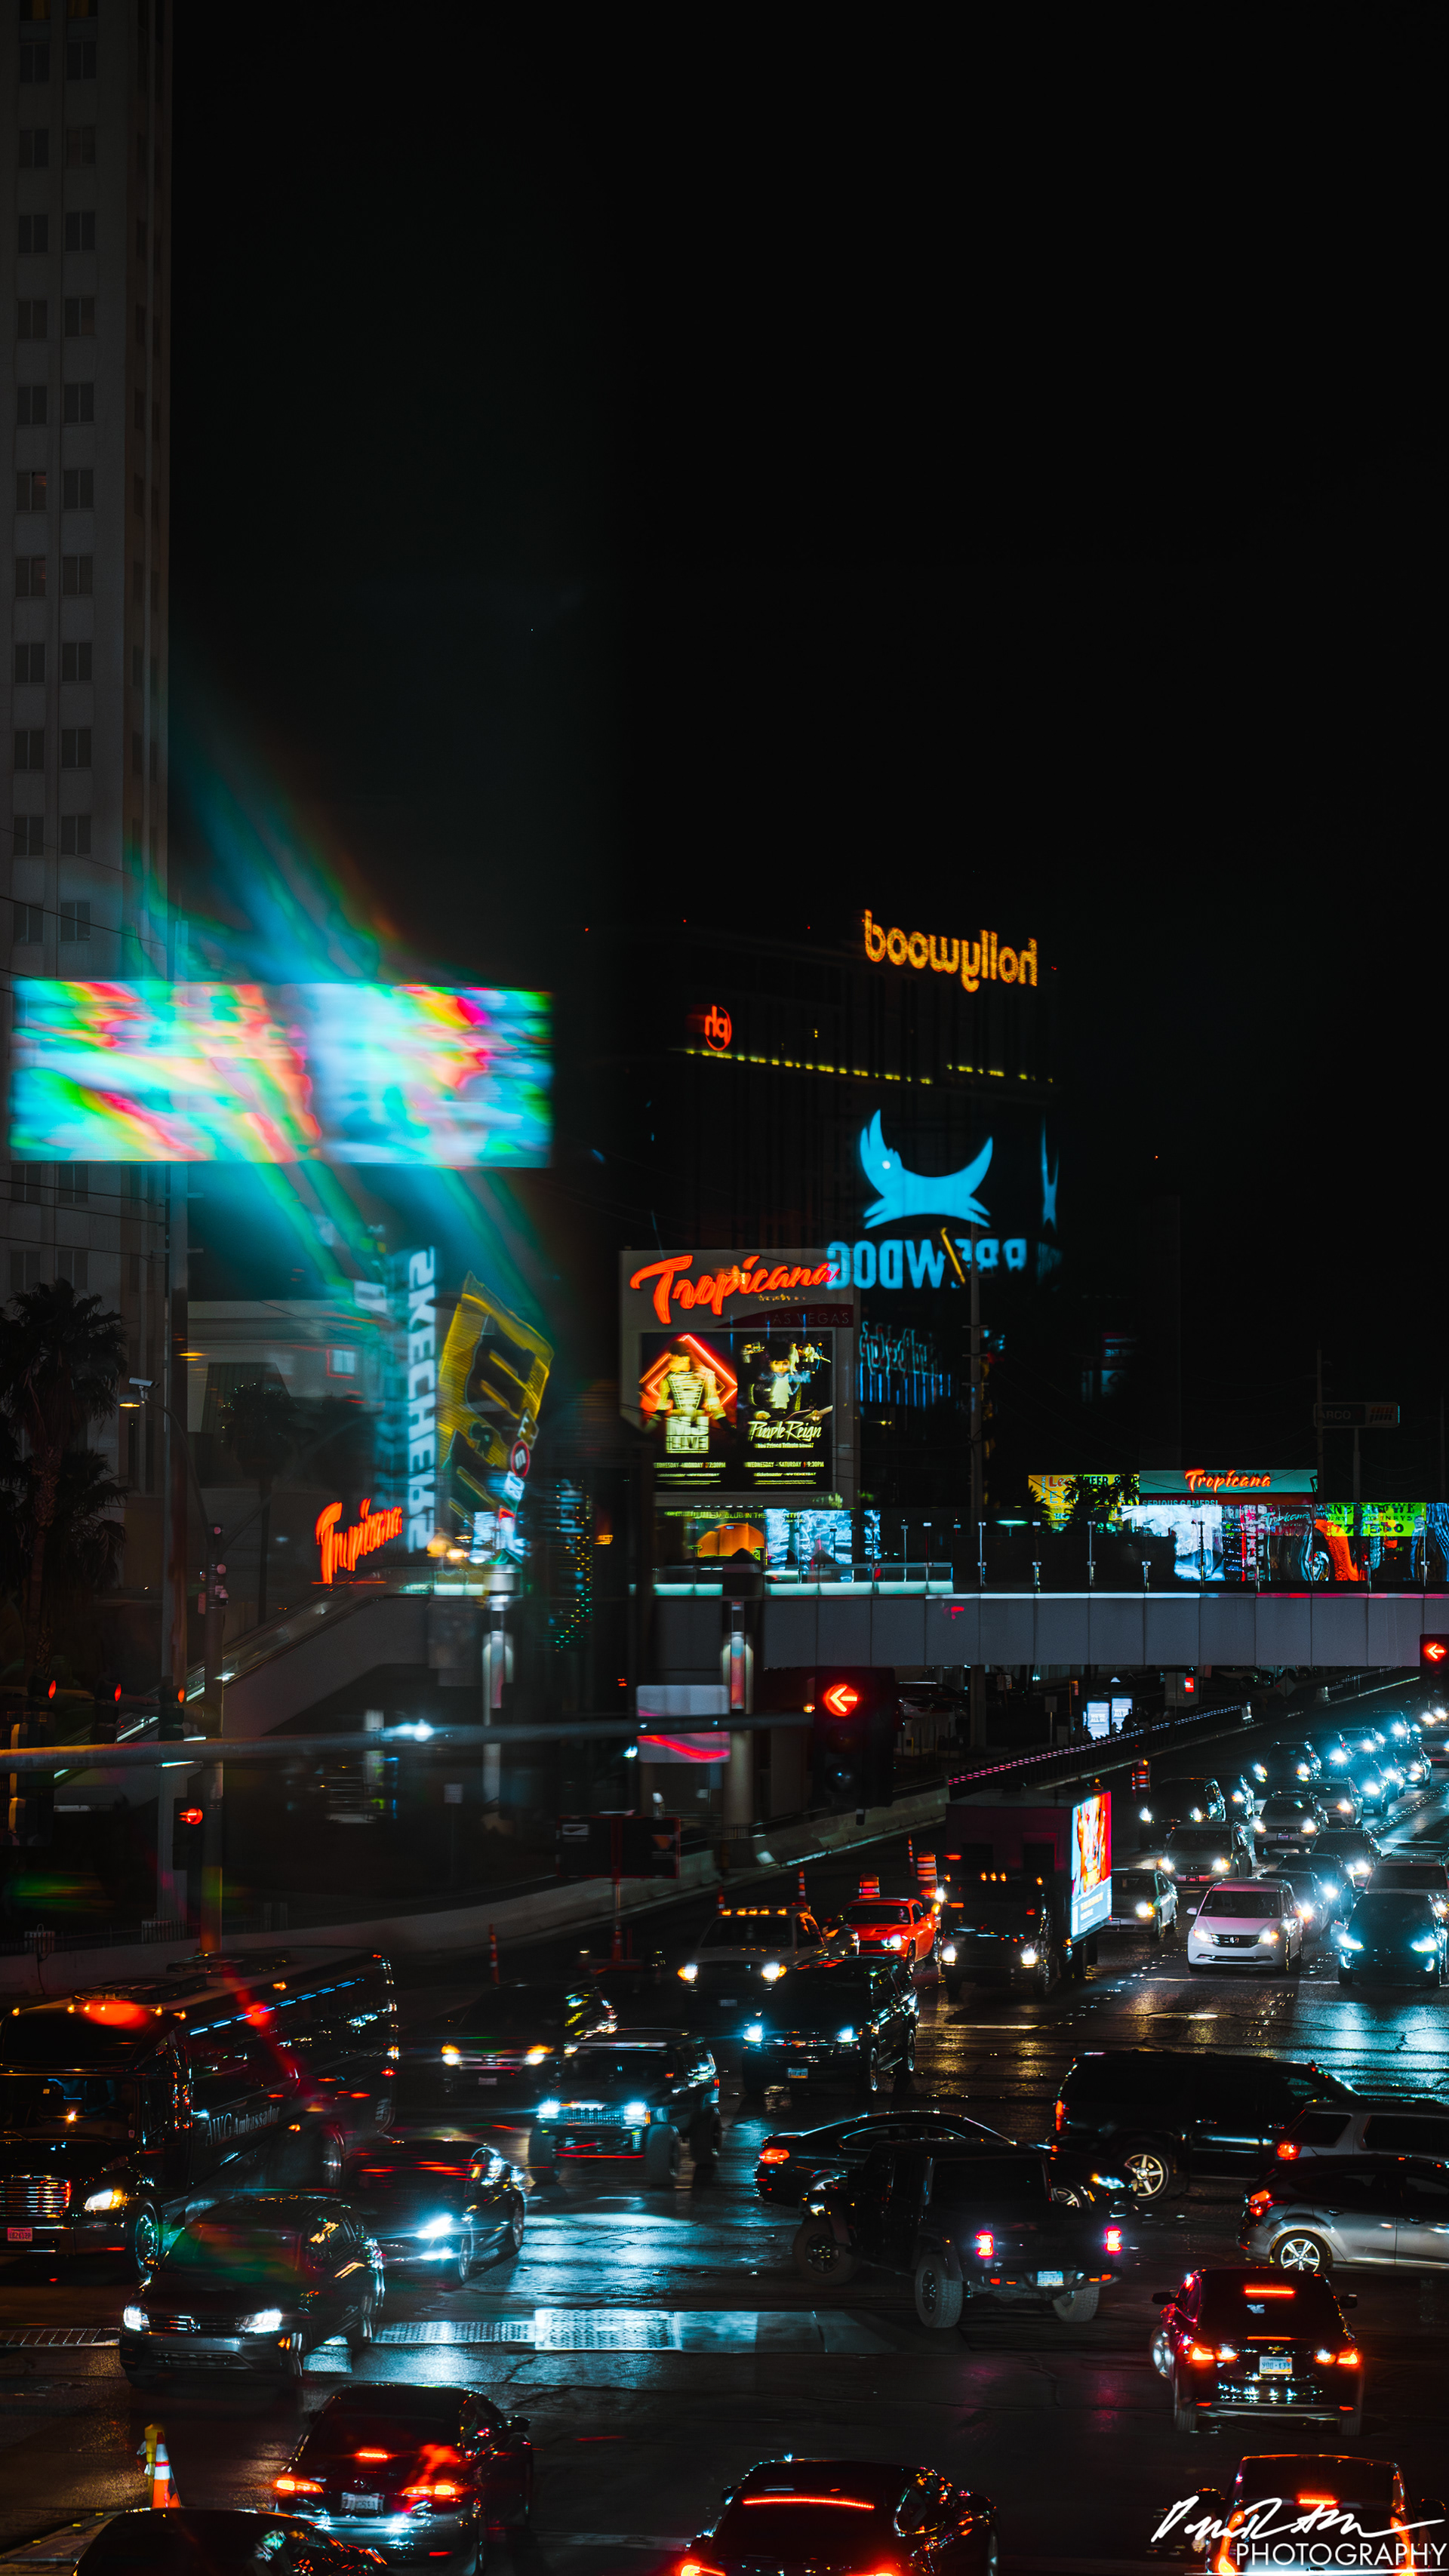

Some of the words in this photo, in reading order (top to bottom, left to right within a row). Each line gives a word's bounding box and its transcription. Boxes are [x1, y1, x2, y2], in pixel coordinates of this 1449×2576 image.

[629, 1255, 840, 1325] Tropicana
[667, 1437, 709, 1449] LIVE
[748, 1421, 786, 1441] Purple
[784, 1421, 822, 1442] Reign
[1185, 1469, 1271, 1493] Tropicana
[205, 2113, 232, 2147] AWG
[234, 2105, 280, 2135] Ambassador
